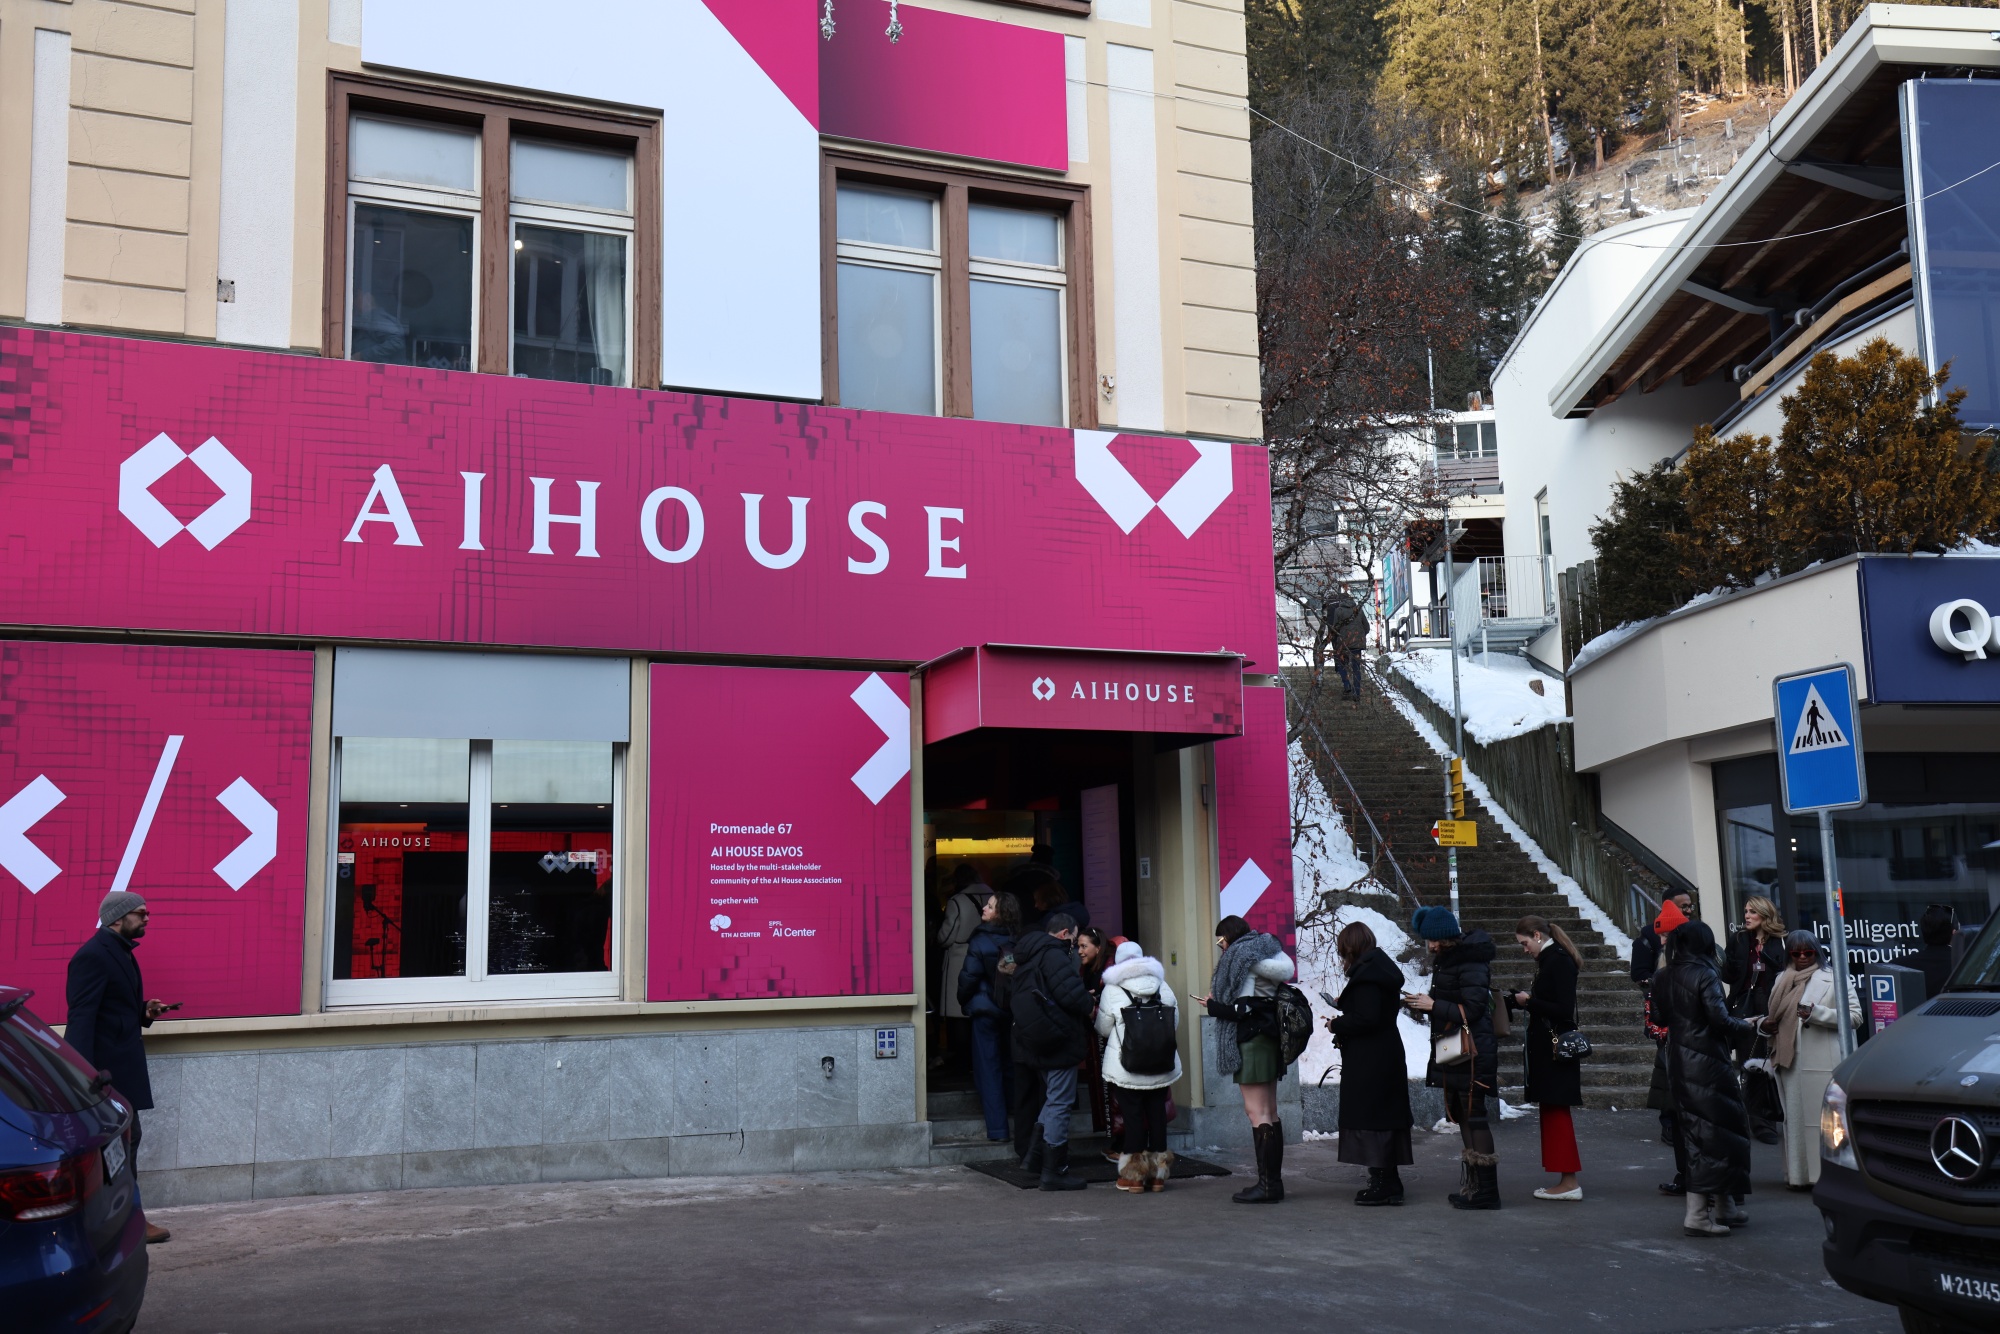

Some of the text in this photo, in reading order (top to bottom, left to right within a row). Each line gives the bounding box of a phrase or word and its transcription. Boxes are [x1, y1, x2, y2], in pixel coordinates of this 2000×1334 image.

[343, 463, 967, 579] AIHOUSE
[1071, 681, 1194, 703] AIHOUSE
[710, 823, 793, 834] Promenade 67
[711, 846, 803, 857] AI HOUSE DAVOS
[710, 863, 822, 872] Hosted by the multi-stakeholder
[710, 877, 750, 886] community
[710, 897, 742, 906] together
[772, 928, 816, 937] AI Center
[1813, 920, 1919, 942] Inelligent
[1875, 979, 1890, 999] P
